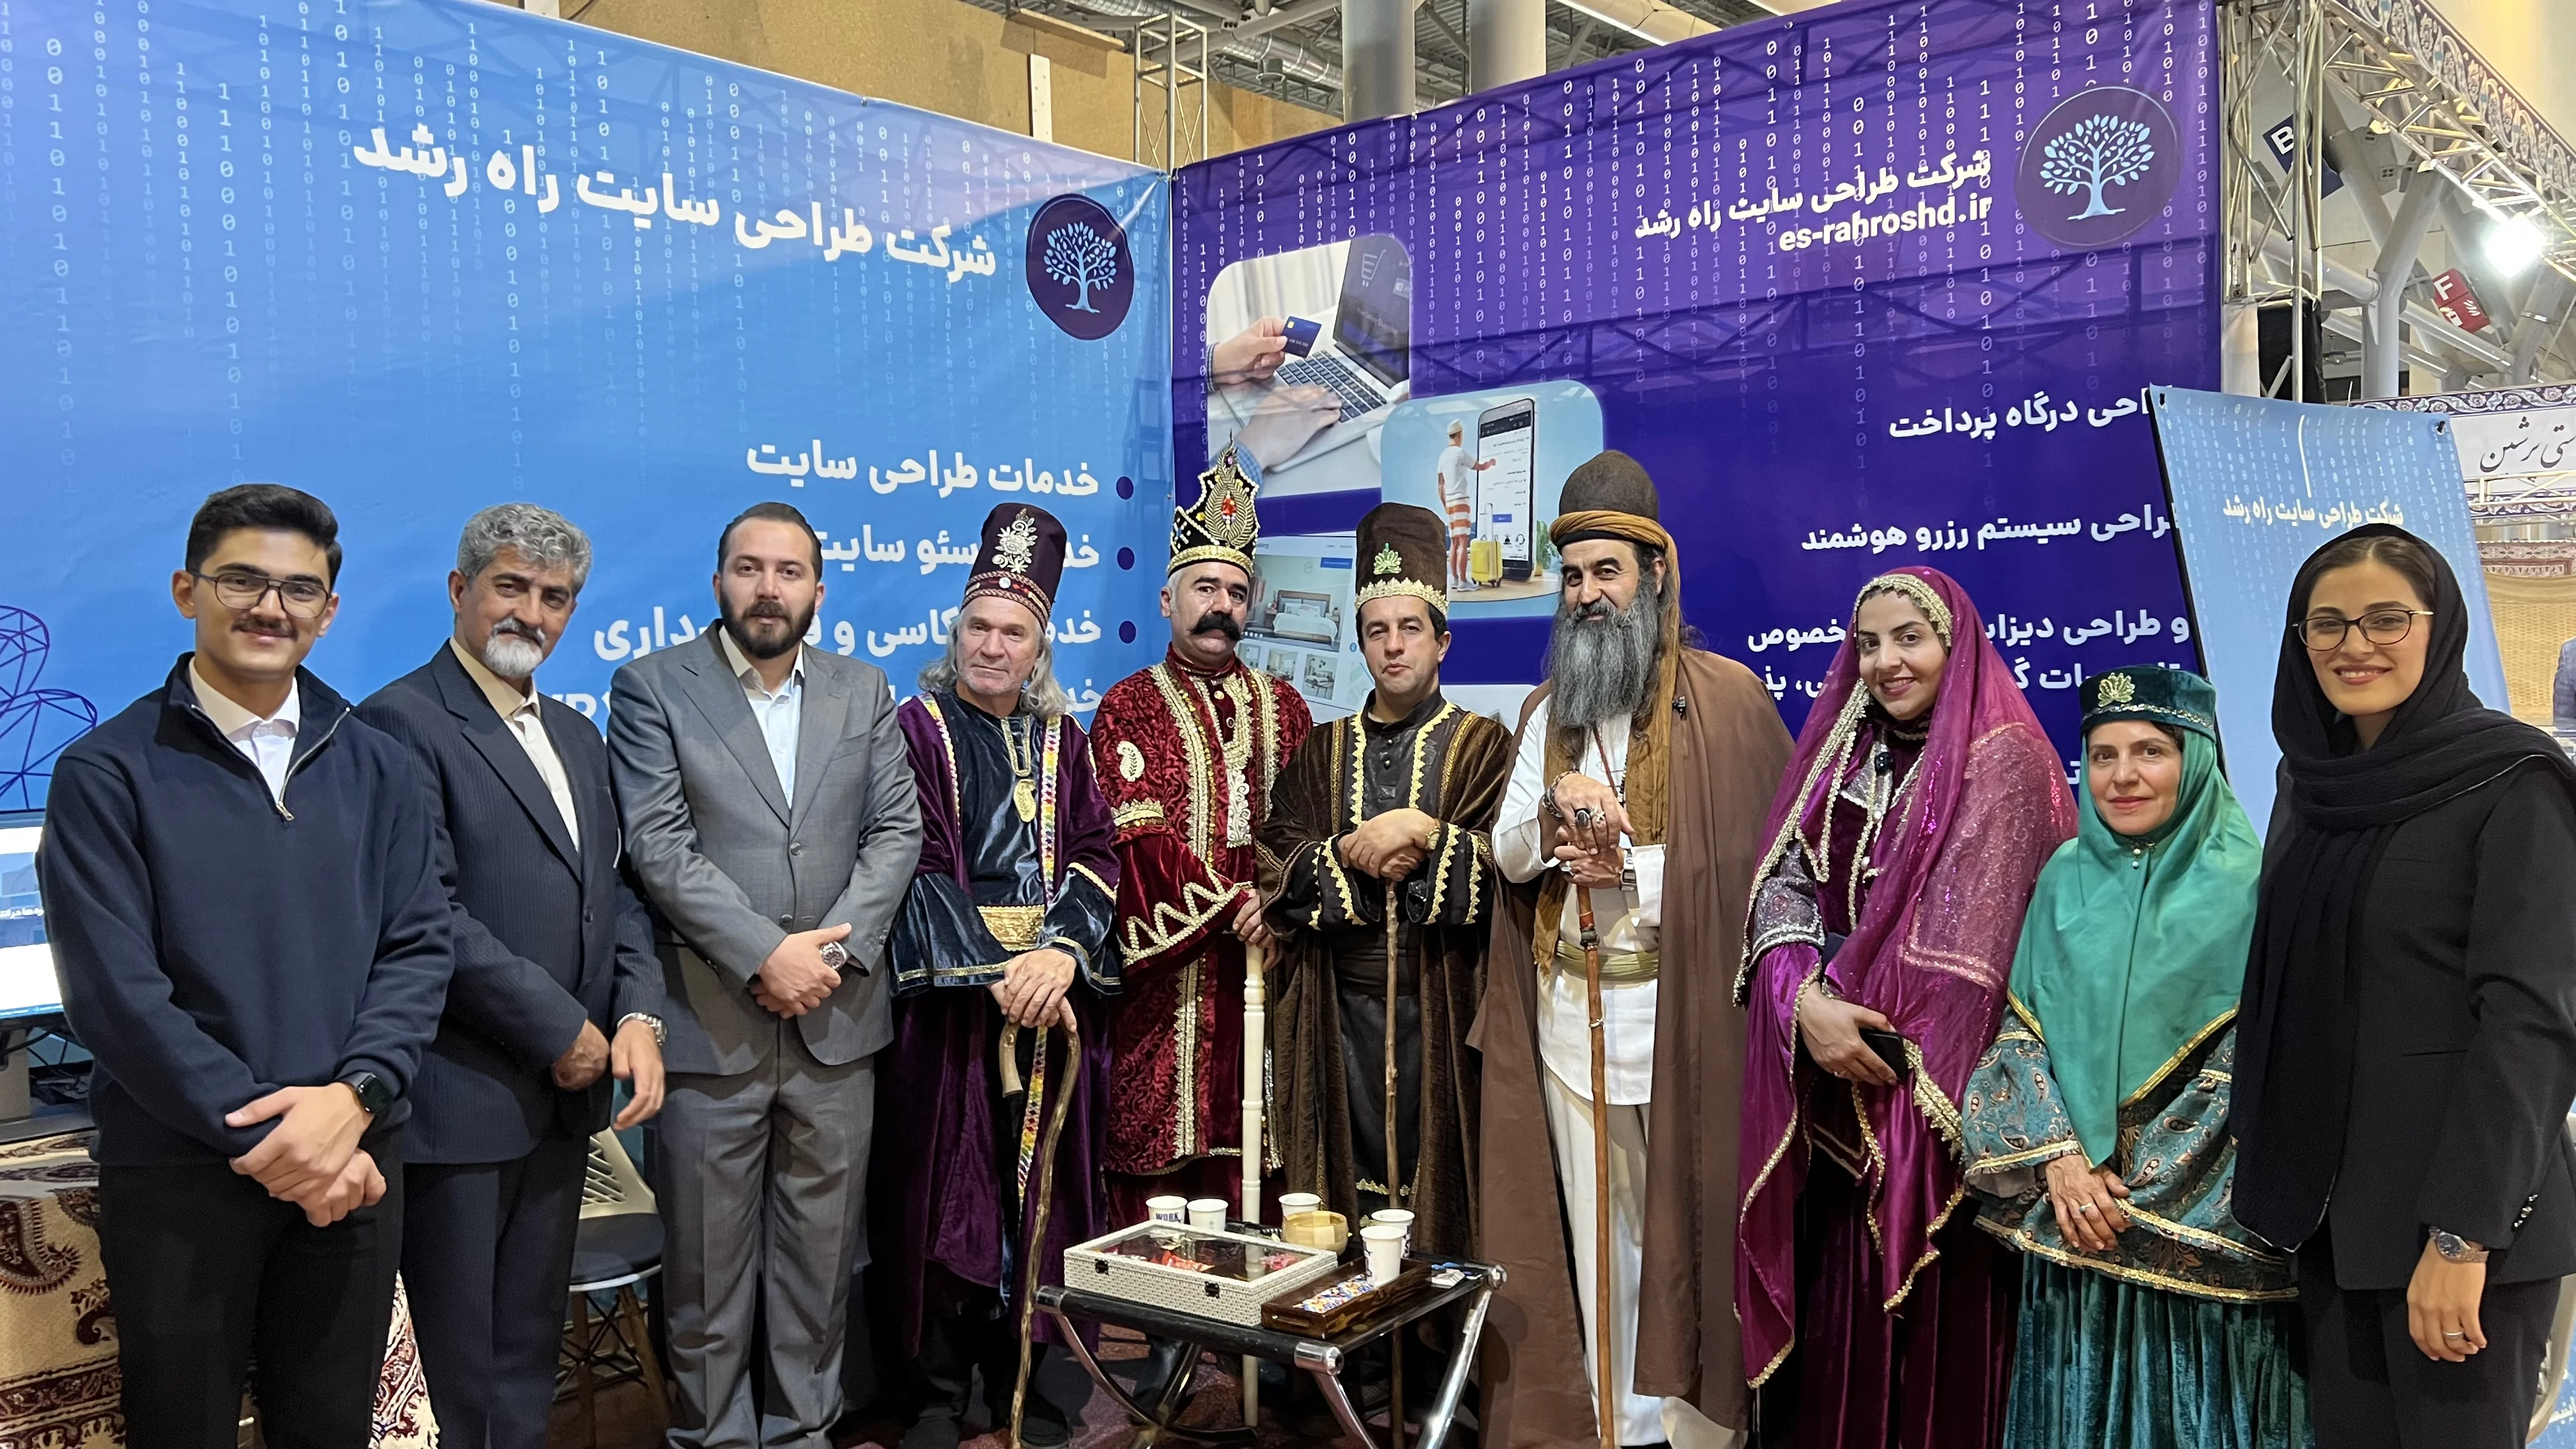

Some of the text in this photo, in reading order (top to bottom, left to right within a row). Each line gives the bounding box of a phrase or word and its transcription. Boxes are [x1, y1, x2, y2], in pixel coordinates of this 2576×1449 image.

[354, 123, 995, 282] شرکت طراحی سایت راه رشد
[1636, 150, 1990, 239] شرکت طراحی سایت راه رشد
[1779, 192, 1992, 251] es-rahroshd.ir
[2434, 275, 2453, 300] F
[1890, 408, 1997, 439] پرداخت
[2007, 392, 2078, 429] درگاه
[747, 440, 1098, 498] خدمات طراحی سایت
[2223, 494, 2250, 524] رشد
[2253, 496, 2273, 525] راه
[2275, 499, 2315, 526] سایت
[2319, 500, 2363, 530] طراحی
[1802, 505, 2172, 553] راحی سیستم رزرو هوشمند
[834, 622, 854, 656] و
[868, 607, 959, 657] کاسی
[2064, 610, 2160, 645] طراحی
[2172, 617, 2188, 643] و
